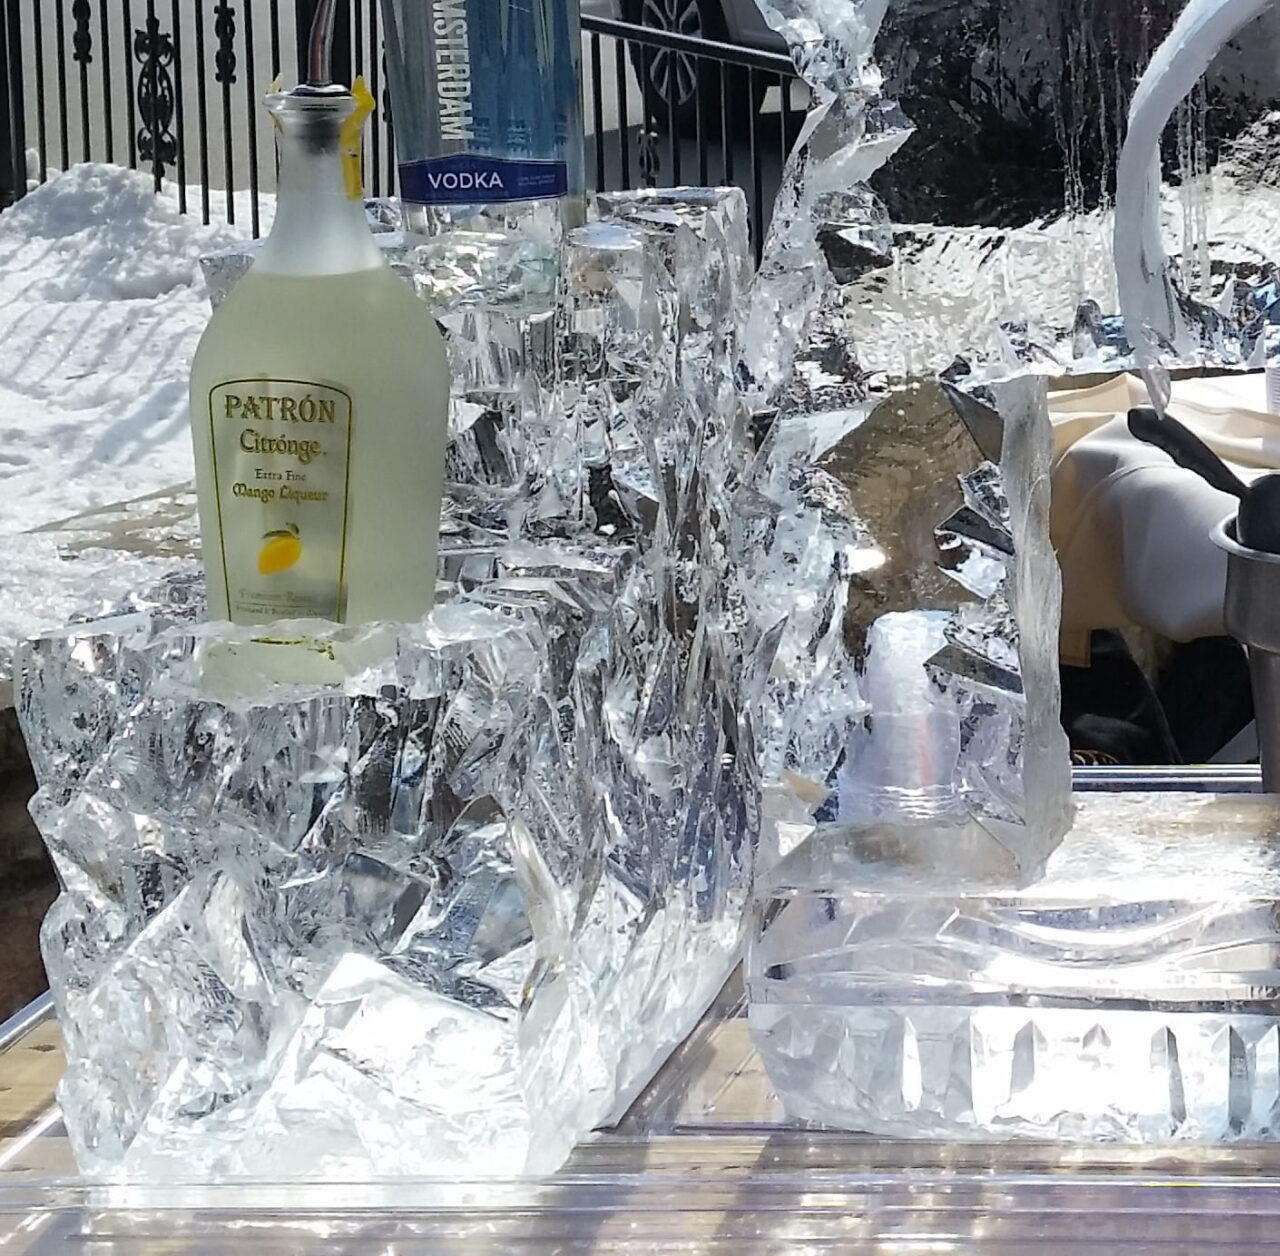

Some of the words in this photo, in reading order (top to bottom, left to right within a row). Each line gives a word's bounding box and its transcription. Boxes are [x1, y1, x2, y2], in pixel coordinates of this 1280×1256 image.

[427, 171, 504, 190] VODKA
[224, 393, 337, 424] PATRÓN
[254, 468, 283, 481] Extra
[285, 469, 307, 482] Fine
[232, 482, 275, 504] Mango
